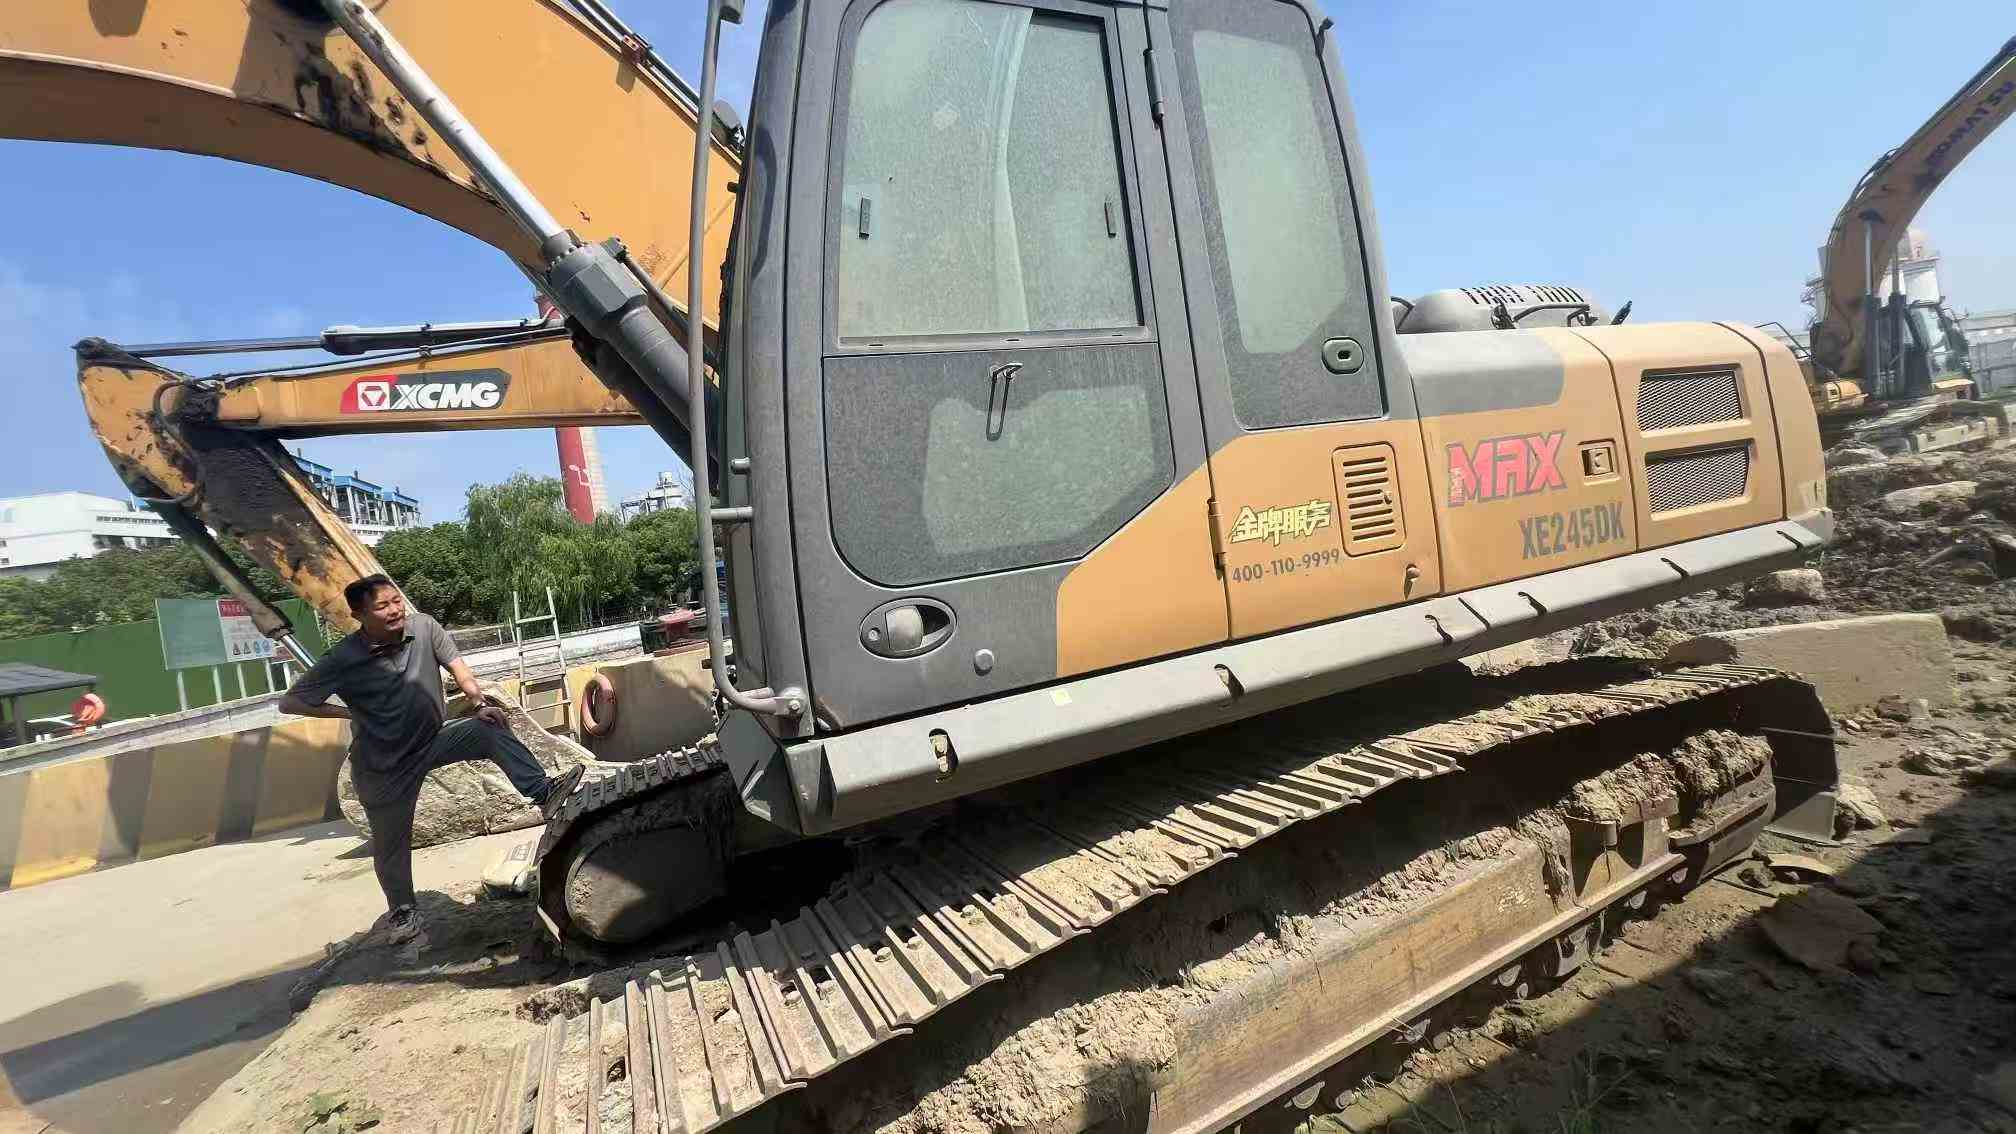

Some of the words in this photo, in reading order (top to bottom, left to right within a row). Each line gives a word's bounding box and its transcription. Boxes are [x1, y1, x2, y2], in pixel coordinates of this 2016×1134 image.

[390, 382, 500, 410] XCMG
[1447, 432, 1567, 507] MAX
[1230, 499, 1332, 547] 金牌服务
[1518, 502, 1625, 560] XE245DK
[1232, 548, 1341, 583] 400-110-9999
